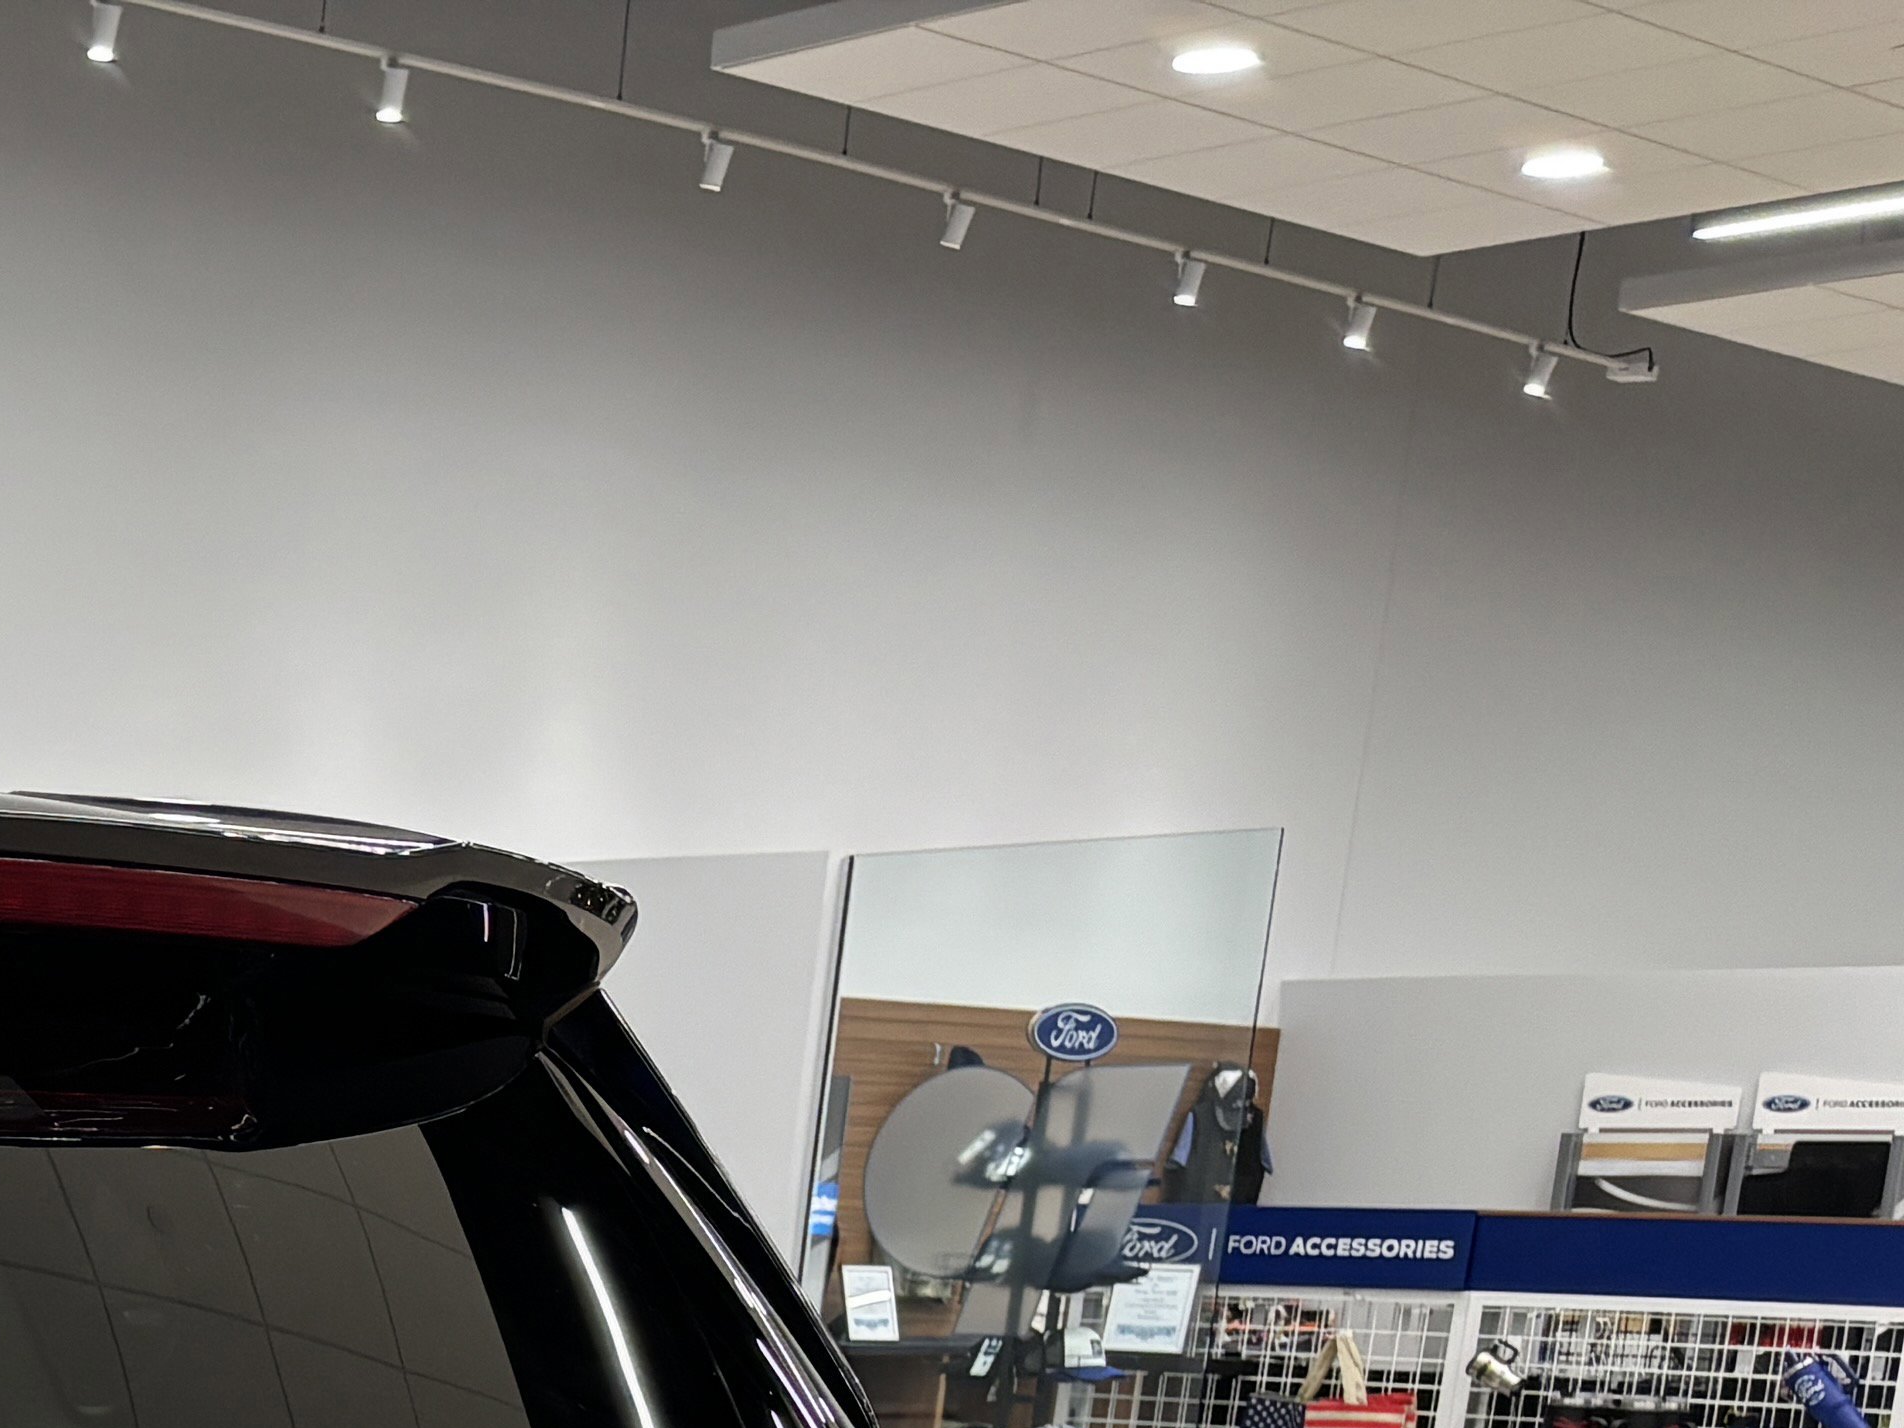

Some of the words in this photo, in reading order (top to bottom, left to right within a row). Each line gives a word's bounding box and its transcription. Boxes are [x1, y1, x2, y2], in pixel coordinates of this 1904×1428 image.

[1050, 1010, 1103, 1049] Ford
[1227, 1234, 1287, 1256] FORD
[1288, 1235, 1456, 1260] ACCESSORIES
